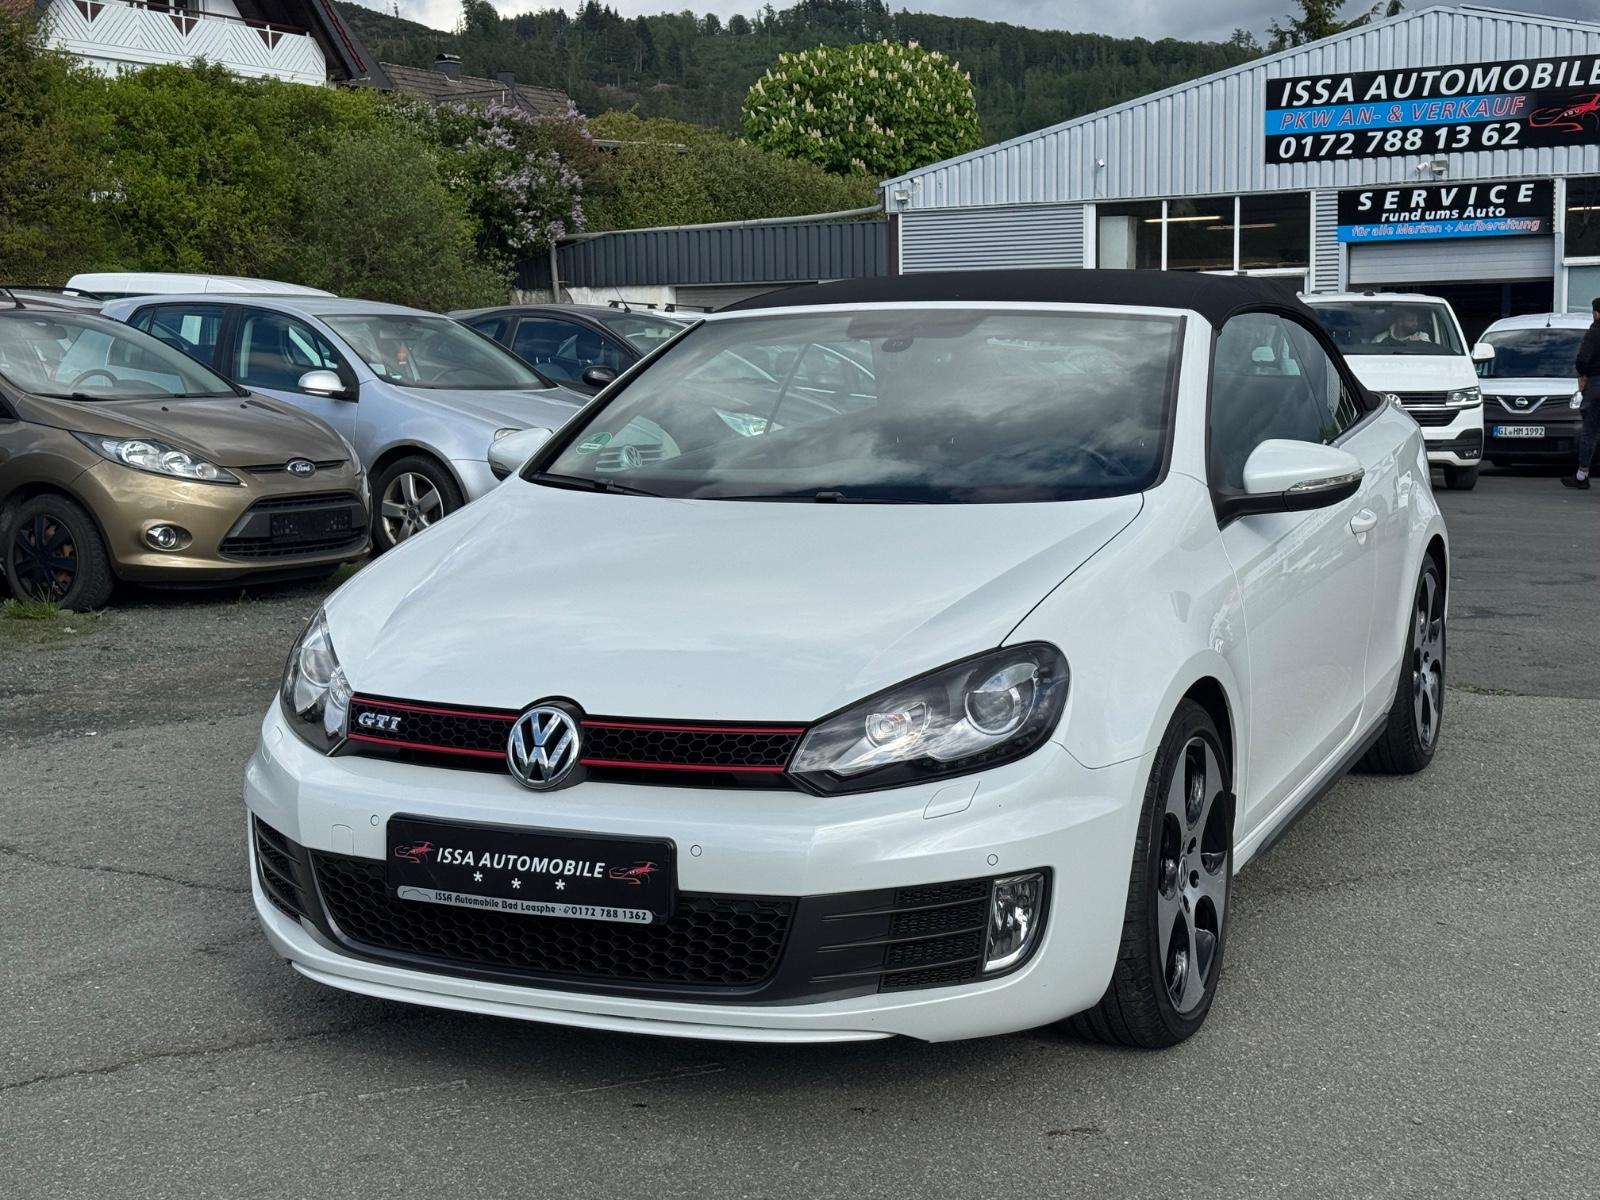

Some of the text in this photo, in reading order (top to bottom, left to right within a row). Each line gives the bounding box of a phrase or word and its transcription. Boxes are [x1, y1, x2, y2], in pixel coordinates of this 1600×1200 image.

[1280, 77, 1354, 107] ISSA
[1280, 95, 1526, 131] PKW AN- & VERKAUF
[1279, 121, 1521, 159] 0172 788 13 62
[1357, 183, 1535, 211] SERVICE
[1351, 224, 1370, 237] für
[1371, 225, 1394, 236] alle
[1396, 222, 1442, 235] Marken
[1455, 218, 1541, 232] Aufbereitung
[1381, 205, 1506, 222] rund ums Auto
[358, 711, 402, 731] GTI
[509, 709, 577, 785] VW
[436, 847, 606, 878] ISSA AUTOMOBILE
[435, 892, 647, 921] ISSA Automobile Bad Laasphe 0172 788 1362
